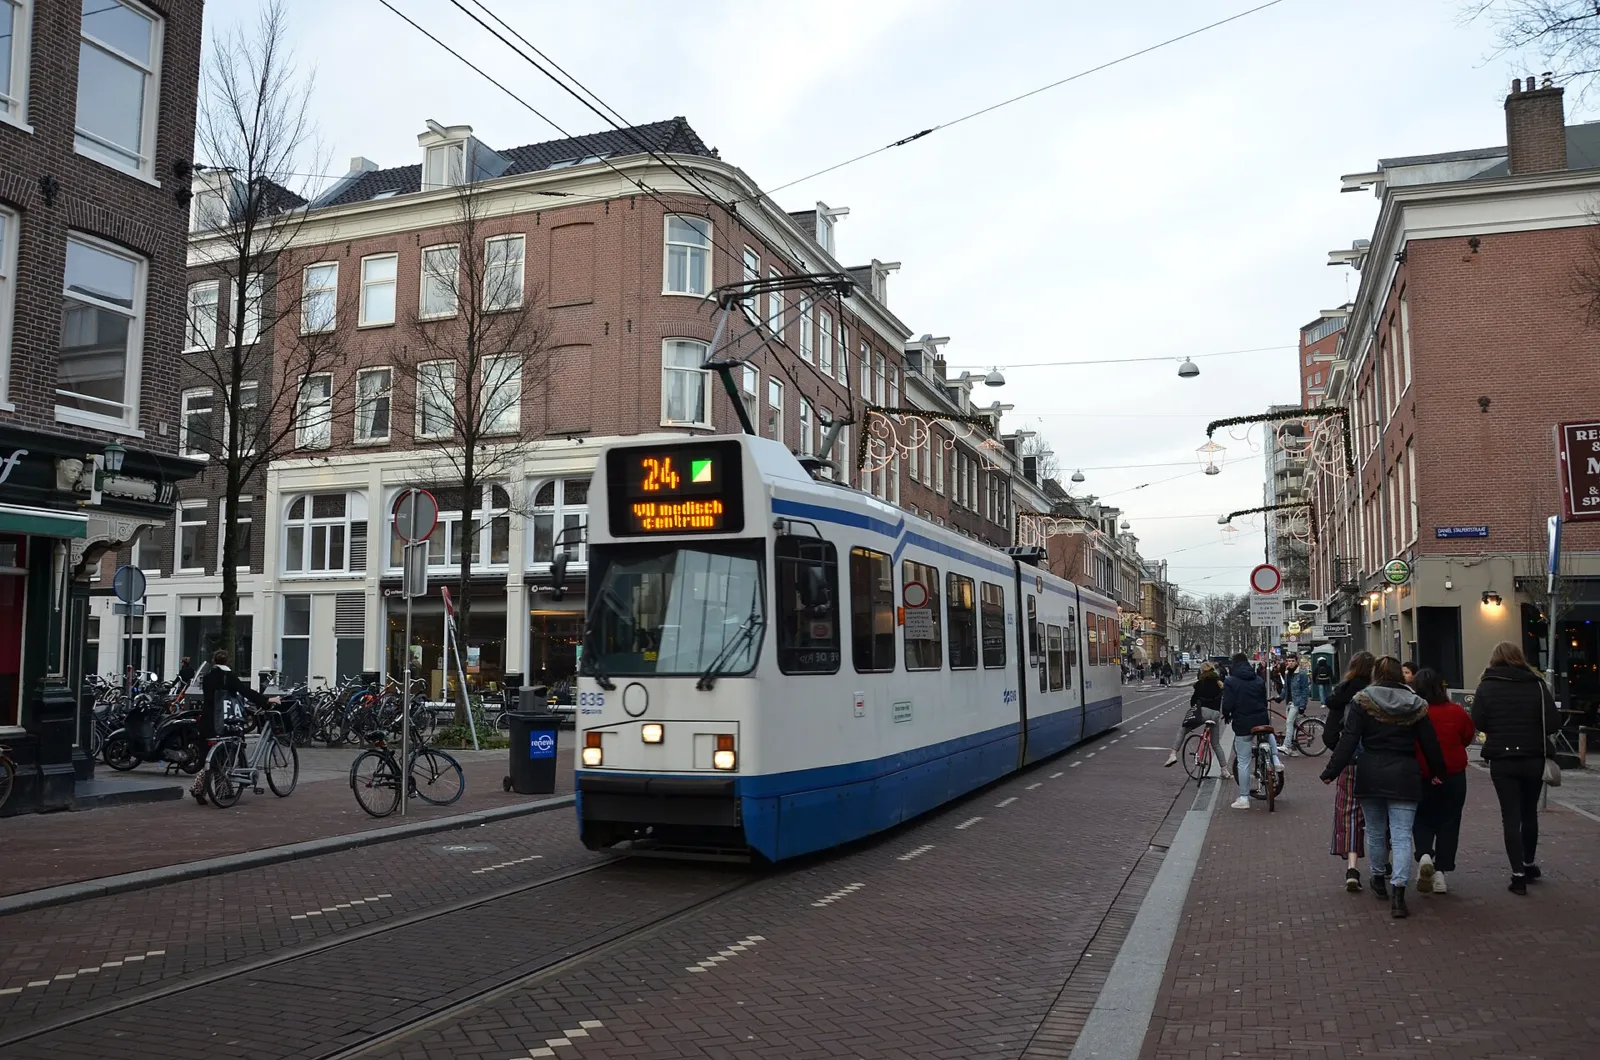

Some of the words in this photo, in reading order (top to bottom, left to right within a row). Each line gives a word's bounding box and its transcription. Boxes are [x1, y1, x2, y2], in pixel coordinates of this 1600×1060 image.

[641, 457, 680, 491] 24
[660, 500, 723, 516] medisch
[642, 514, 714, 530] centrum
[580, 692, 605, 707] 835
